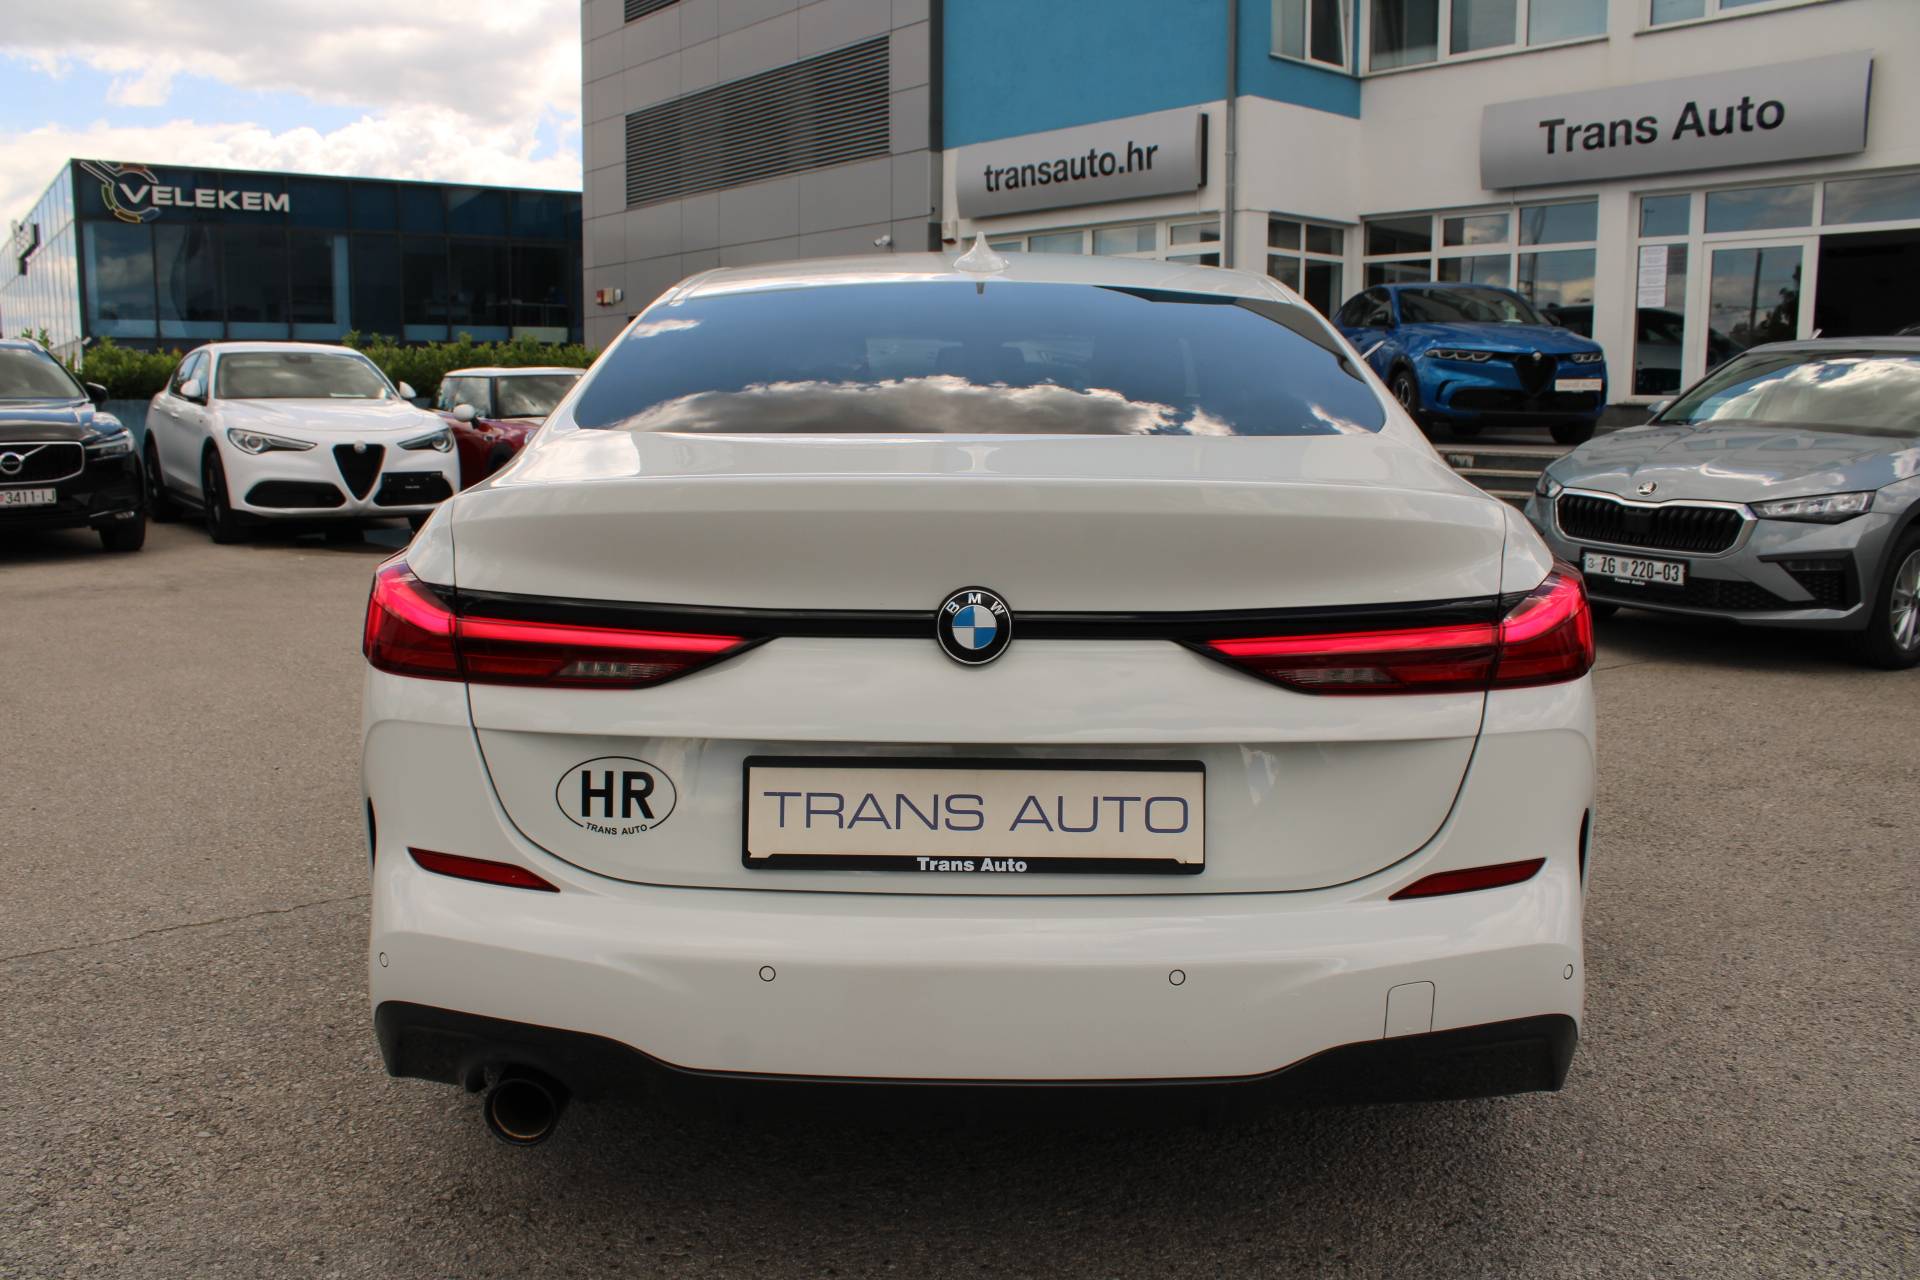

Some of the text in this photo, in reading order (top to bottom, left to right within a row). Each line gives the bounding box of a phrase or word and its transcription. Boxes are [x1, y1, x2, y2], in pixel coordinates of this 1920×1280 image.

[1539, 96, 1786, 155] Trans Auto
[984, 141, 1159, 192] transauto.hr
[119, 183, 291, 213] VELEKEM
[1600, 556, 1616, 574] ZG
[1631, 560, 1680, 582] 220-03
[945, 592, 1006, 616] BMW
[581, 770, 655, 819] HR
[763, 791, 1189, 834] TRANS AUTO
[586, 822, 648, 836] TRANS AUTO
[916, 857, 1028, 872] Trans Auto
